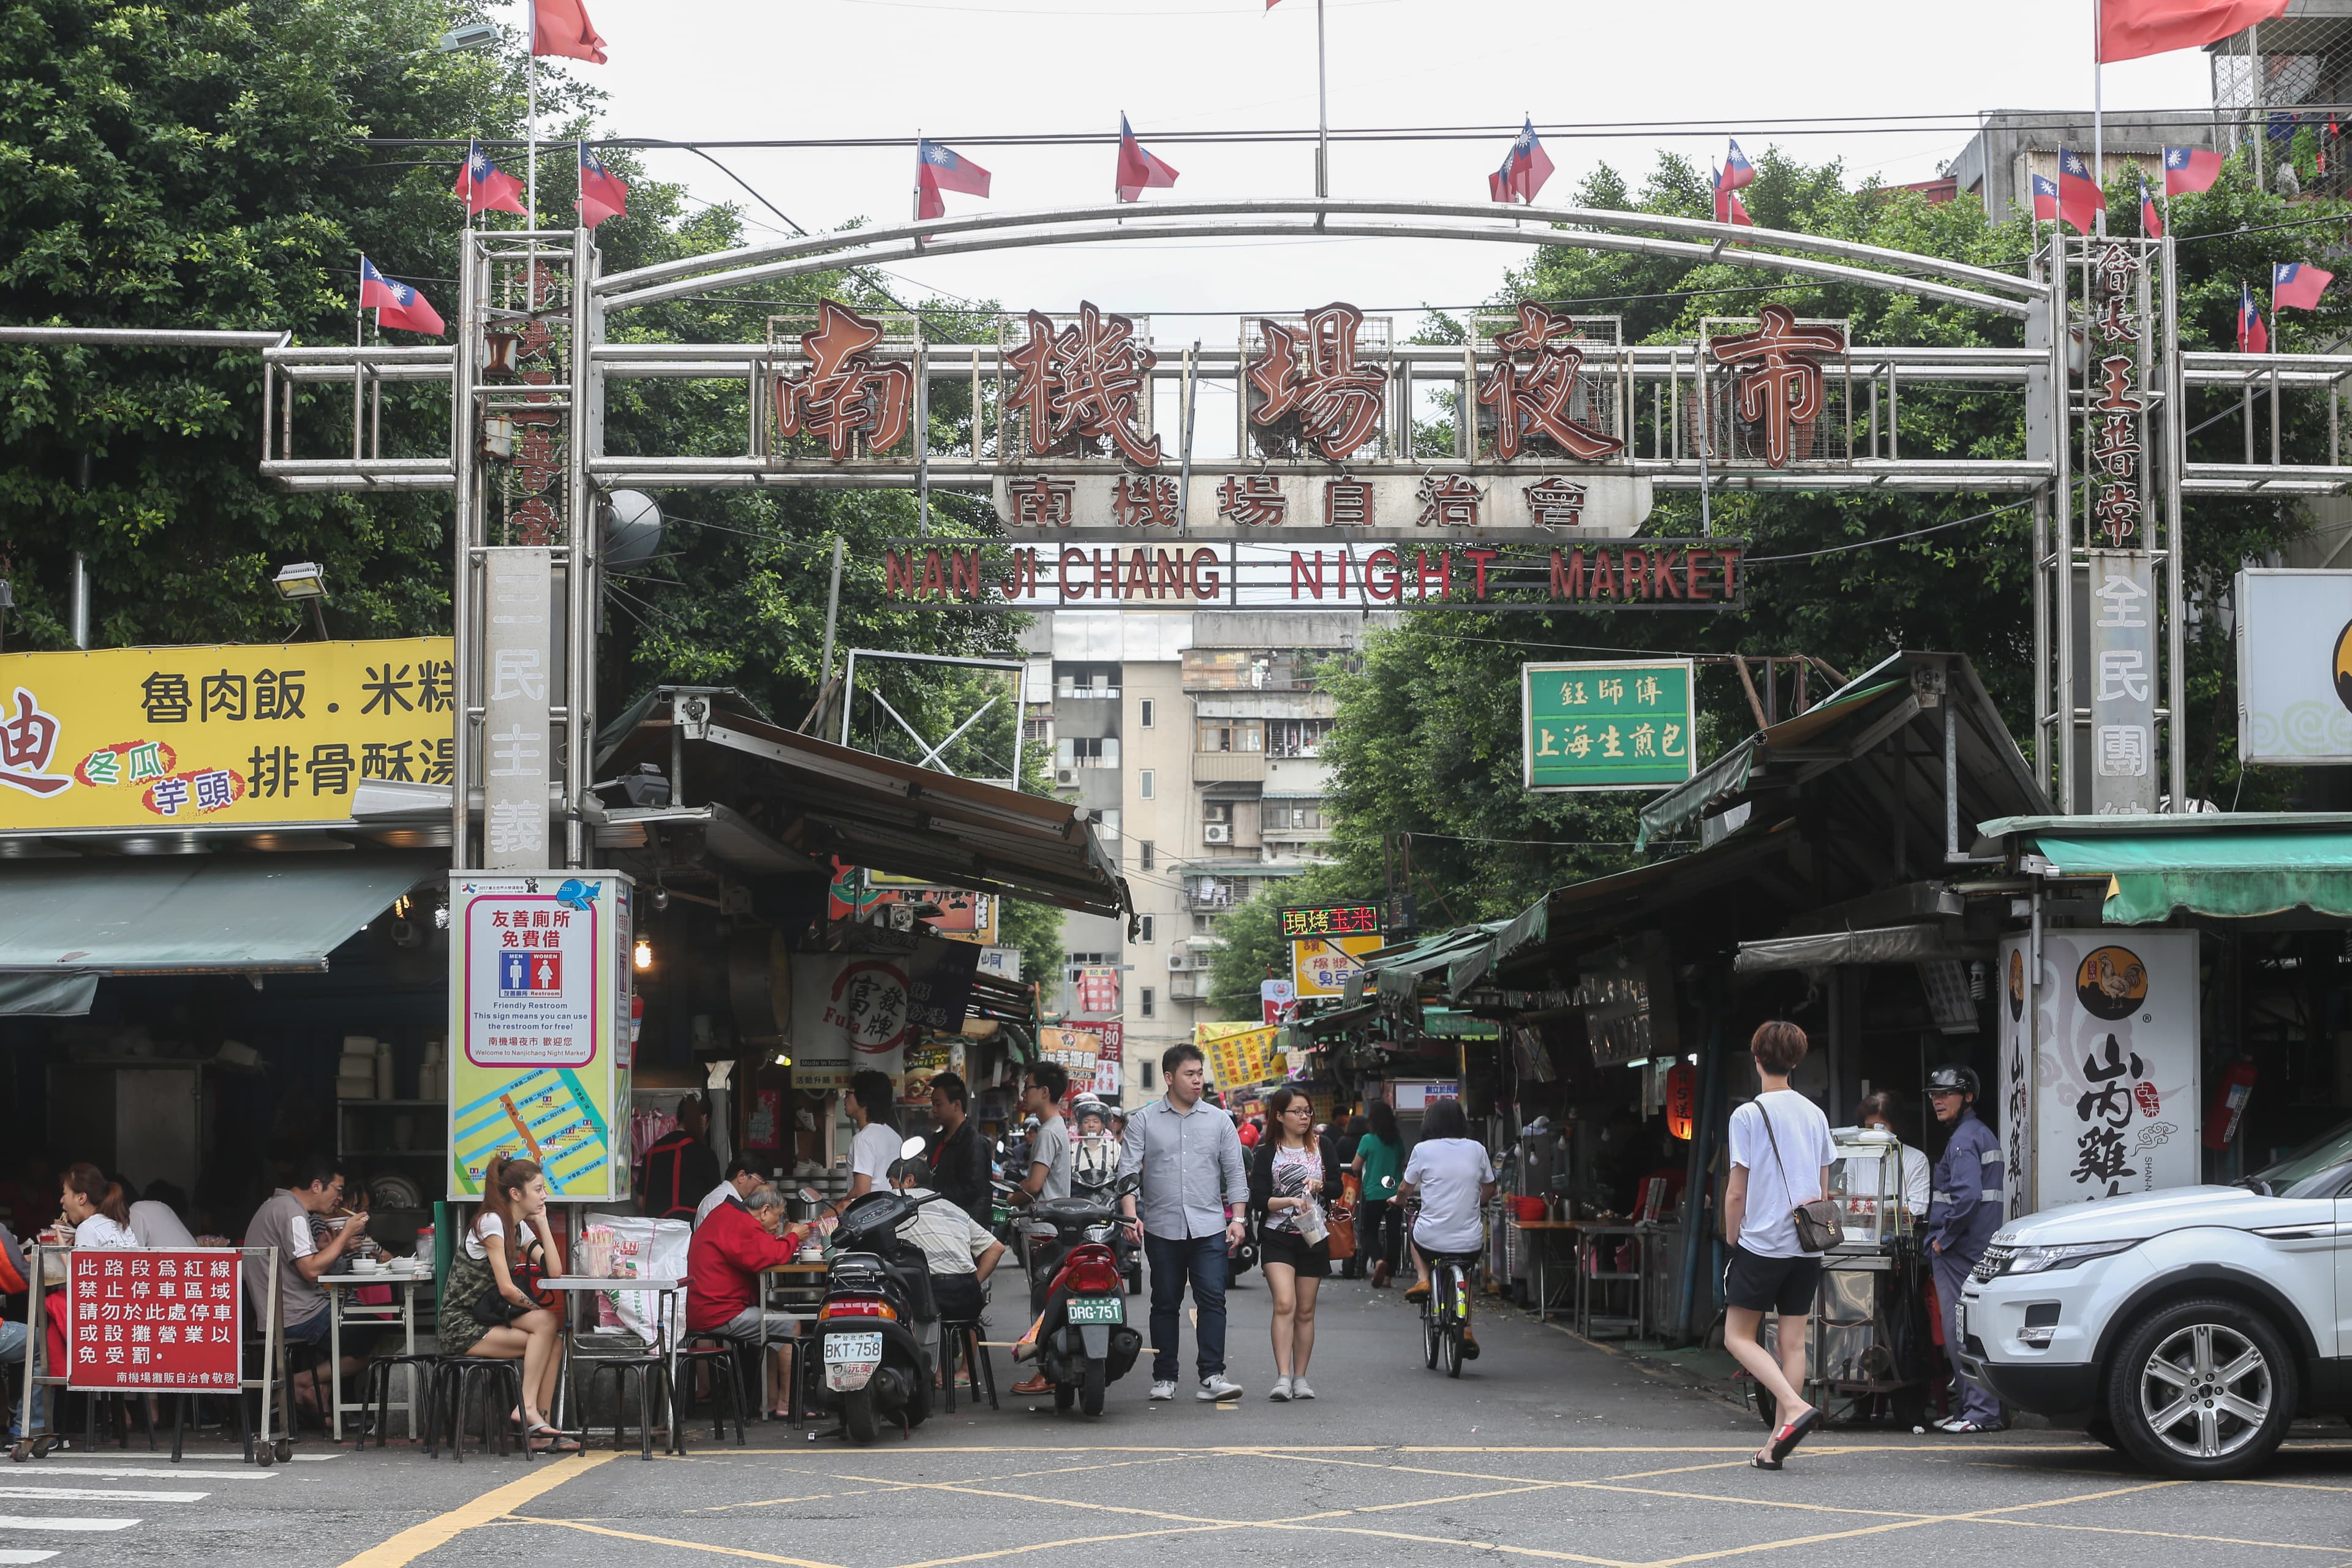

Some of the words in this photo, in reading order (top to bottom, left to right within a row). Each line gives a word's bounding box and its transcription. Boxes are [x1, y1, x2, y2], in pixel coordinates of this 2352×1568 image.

[775, 297, 1845, 469] 南機場夜市
[1009, 473, 1588, 528] 南機場自治會
[887, 548, 979, 599] NAN
[1001, 548, 1036, 599] JI
[1059, 548, 1220, 600] CHANG
[1291, 549, 1496, 600] NIGHT
[1550, 548, 1741, 599] MARKET
[1559, 676, 1663, 706] 鈺師傅
[2095, 575, 2149, 814] 全民團
[489, 573, 545, 853] 三民主義
[1536, 722, 1685, 759] 上海生煎包
[86, 741, 165, 785] 冬瓜
[154, 769, 233, 816] 芋頭
[492, 910, 571, 928] 友善廁所
[1286, 907, 1373, 935] 現烤玉米
[502, 930, 560, 949] 免費借
[1313, 957, 1348, 970] 爆漿
[492, 1012, 510, 1021] sign
[488, 1037, 538, 1047] 南機場夜市
[543, 1037, 573, 1047] 歡迎您
[2135, 1085, 2160, 1117] 古早味
[78, 1281, 231, 1300] 禁止停車區域
[78, 1303, 233, 1322] 請勿於此處停車
[78, 1325, 231, 1344] 或設攤營業以
